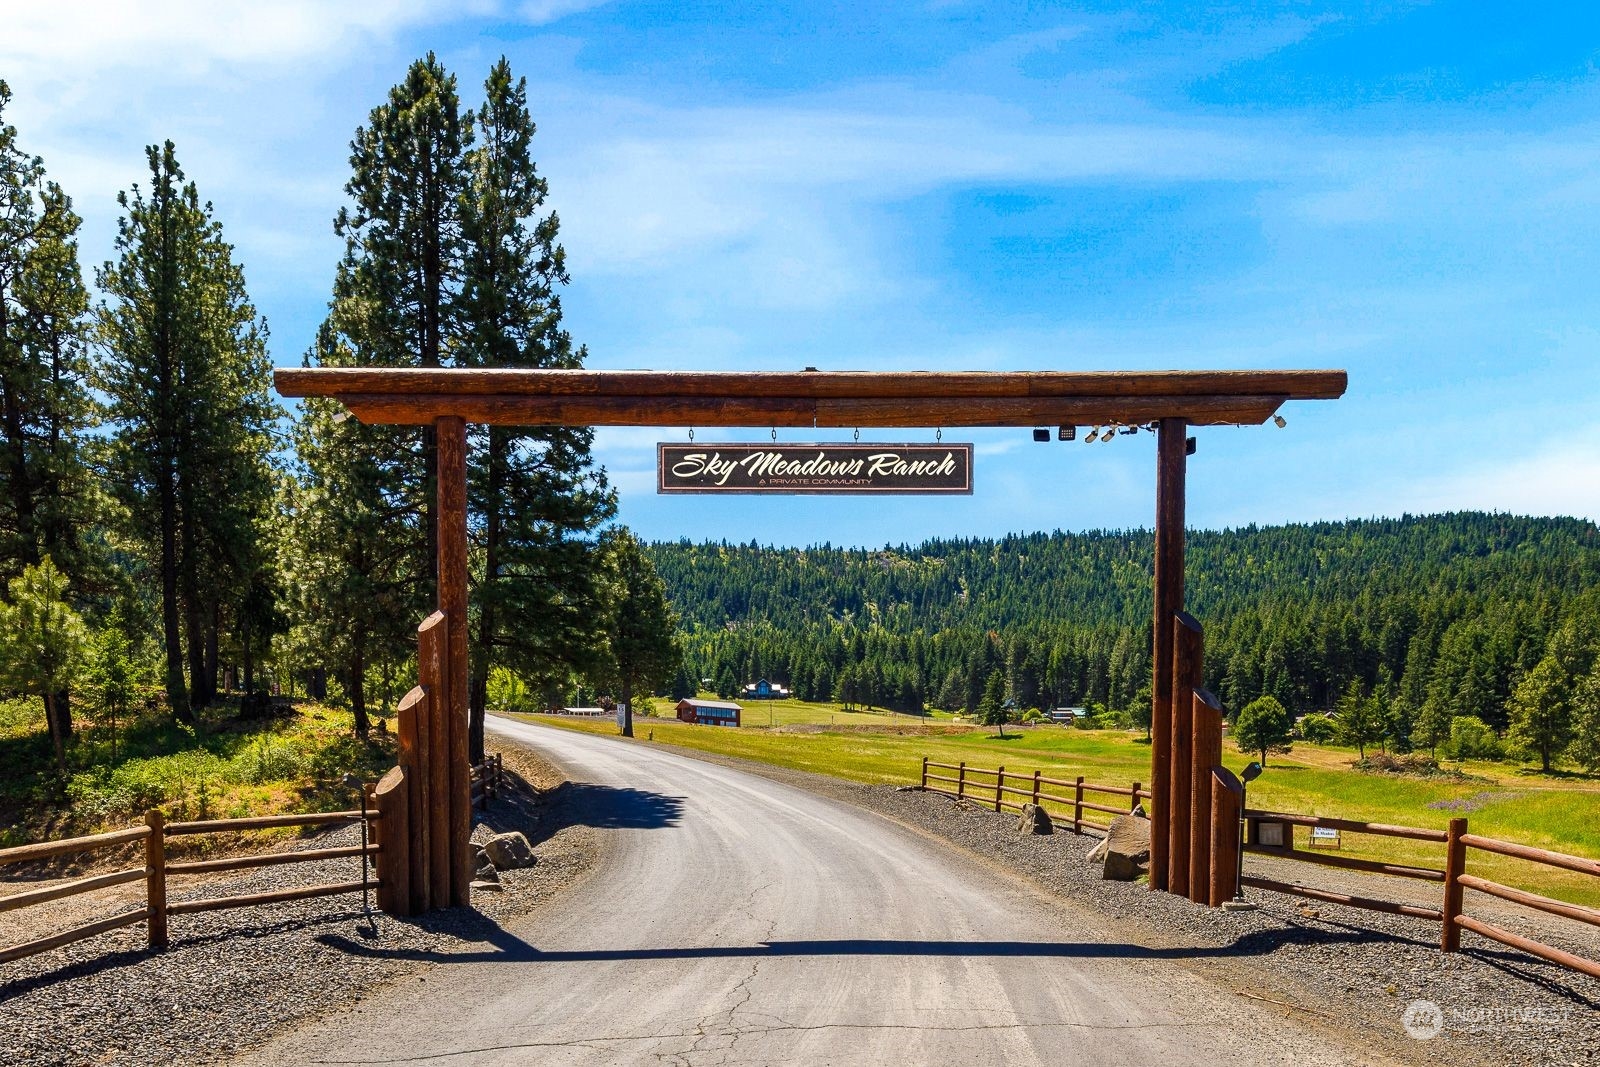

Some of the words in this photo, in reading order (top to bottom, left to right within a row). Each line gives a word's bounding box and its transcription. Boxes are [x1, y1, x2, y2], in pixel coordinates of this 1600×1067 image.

[672, 452, 738, 485] Sky
[740, 451, 863, 477] Meadows
[867, 451, 956, 477] Ranch
